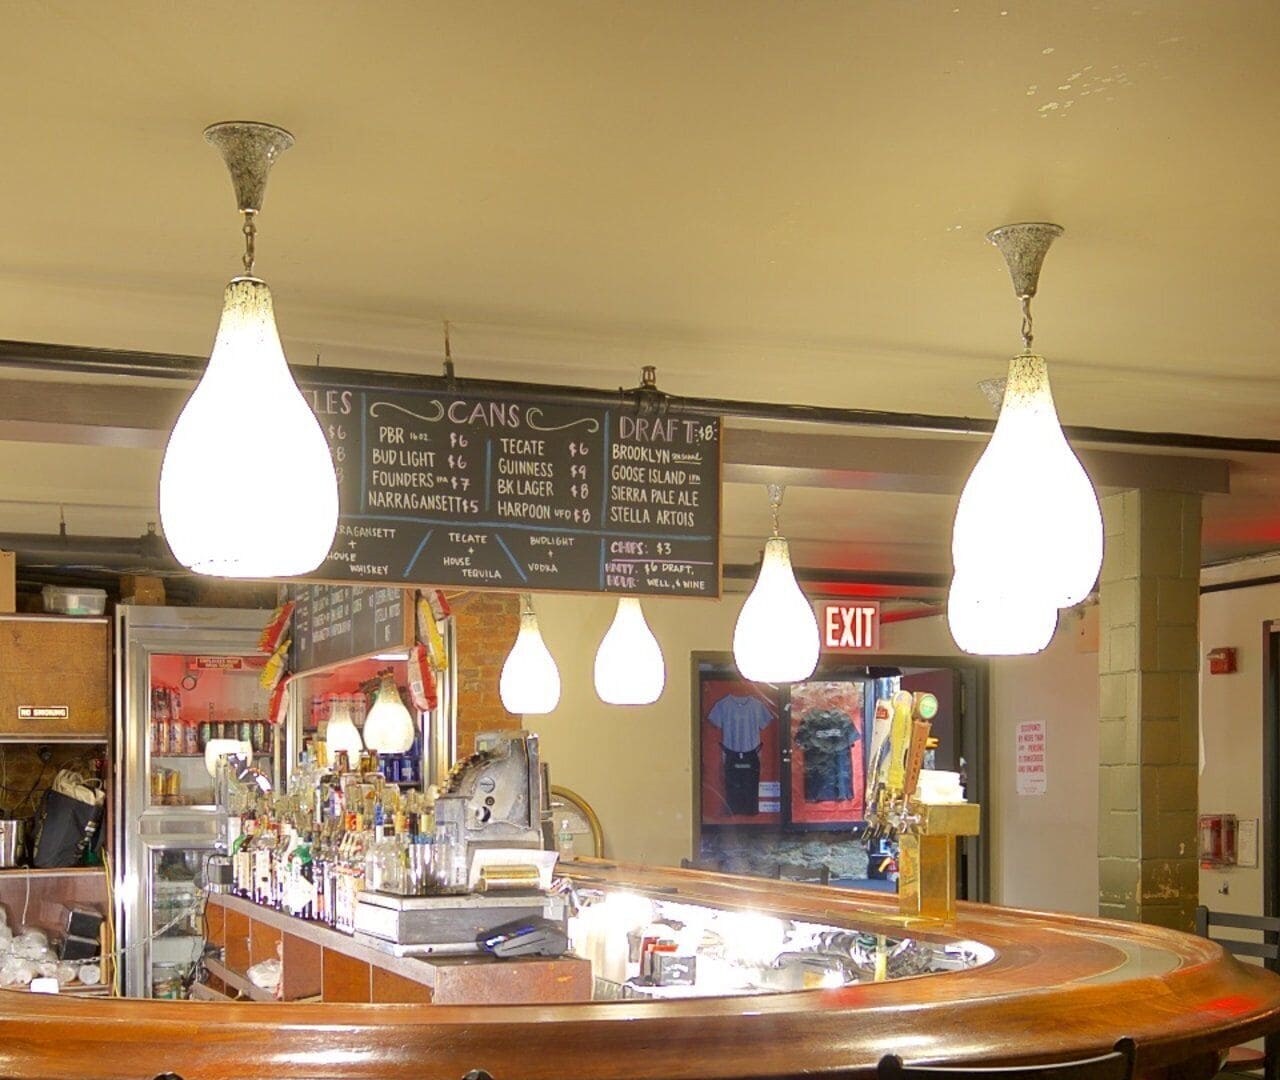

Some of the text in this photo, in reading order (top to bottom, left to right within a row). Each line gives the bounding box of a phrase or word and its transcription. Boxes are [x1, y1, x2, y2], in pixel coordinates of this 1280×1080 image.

[447, 400, 520, 428] CANS
[328, 424, 346, 440] $6
[379, 426, 405, 444] PBR
[450, 432, 468, 448] $6
[619, 415, 700, 443] DRAFT
[500, 438, 589, 457] TECATE $6
[612, 443, 671, 464] BROOKLYN
[372, 448, 467, 469] BUD LIGHT $6
[498, 458, 554, 478] GUINNESS
[372, 470, 434, 488] FOUNDERS
[450, 476, 470, 491] $7
[611, 465, 646, 484] GOOSE
[648, 468, 686, 486] ISLAND
[497, 478, 589, 500] BK LAGER $8
[611, 485, 700, 507] SIERRA PALE ALE
[368, 490, 462, 512] NARRAGANSETT
[497, 500, 551, 519] HARPOON
[573, 508, 591, 524] $8
[610, 505, 695, 528] STELLA ARTOIS
[448, 532, 488, 544] TECATE
[656, 542, 672, 555] $3
[349, 564, 389, 575] WHISKEY
[443, 556, 472, 566] HOUSE
[528, 563, 559, 573] VODKA
[462, 568, 502, 579] TEQUILA
[682, 581, 705, 590] WINE
[826, 606, 876, 648] EXIT
